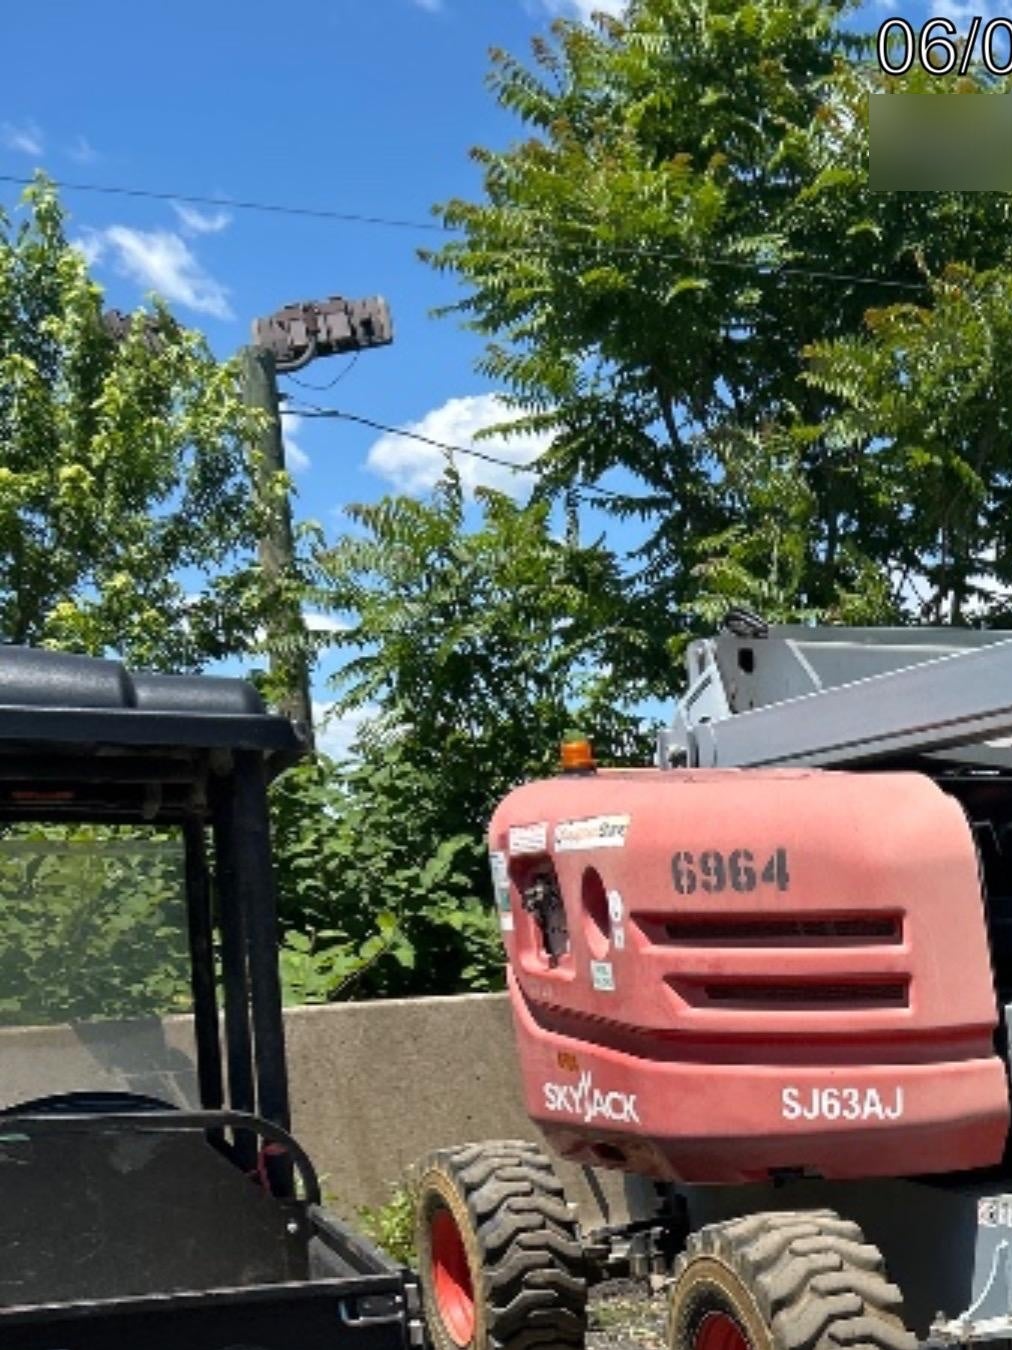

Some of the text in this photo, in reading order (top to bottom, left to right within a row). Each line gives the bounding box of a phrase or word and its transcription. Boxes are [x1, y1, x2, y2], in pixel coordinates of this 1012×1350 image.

[671, 848, 790, 895] 6964
[543, 1070, 640, 1124] SKYJACK
[782, 1087, 904, 1120] SJ63AJ
